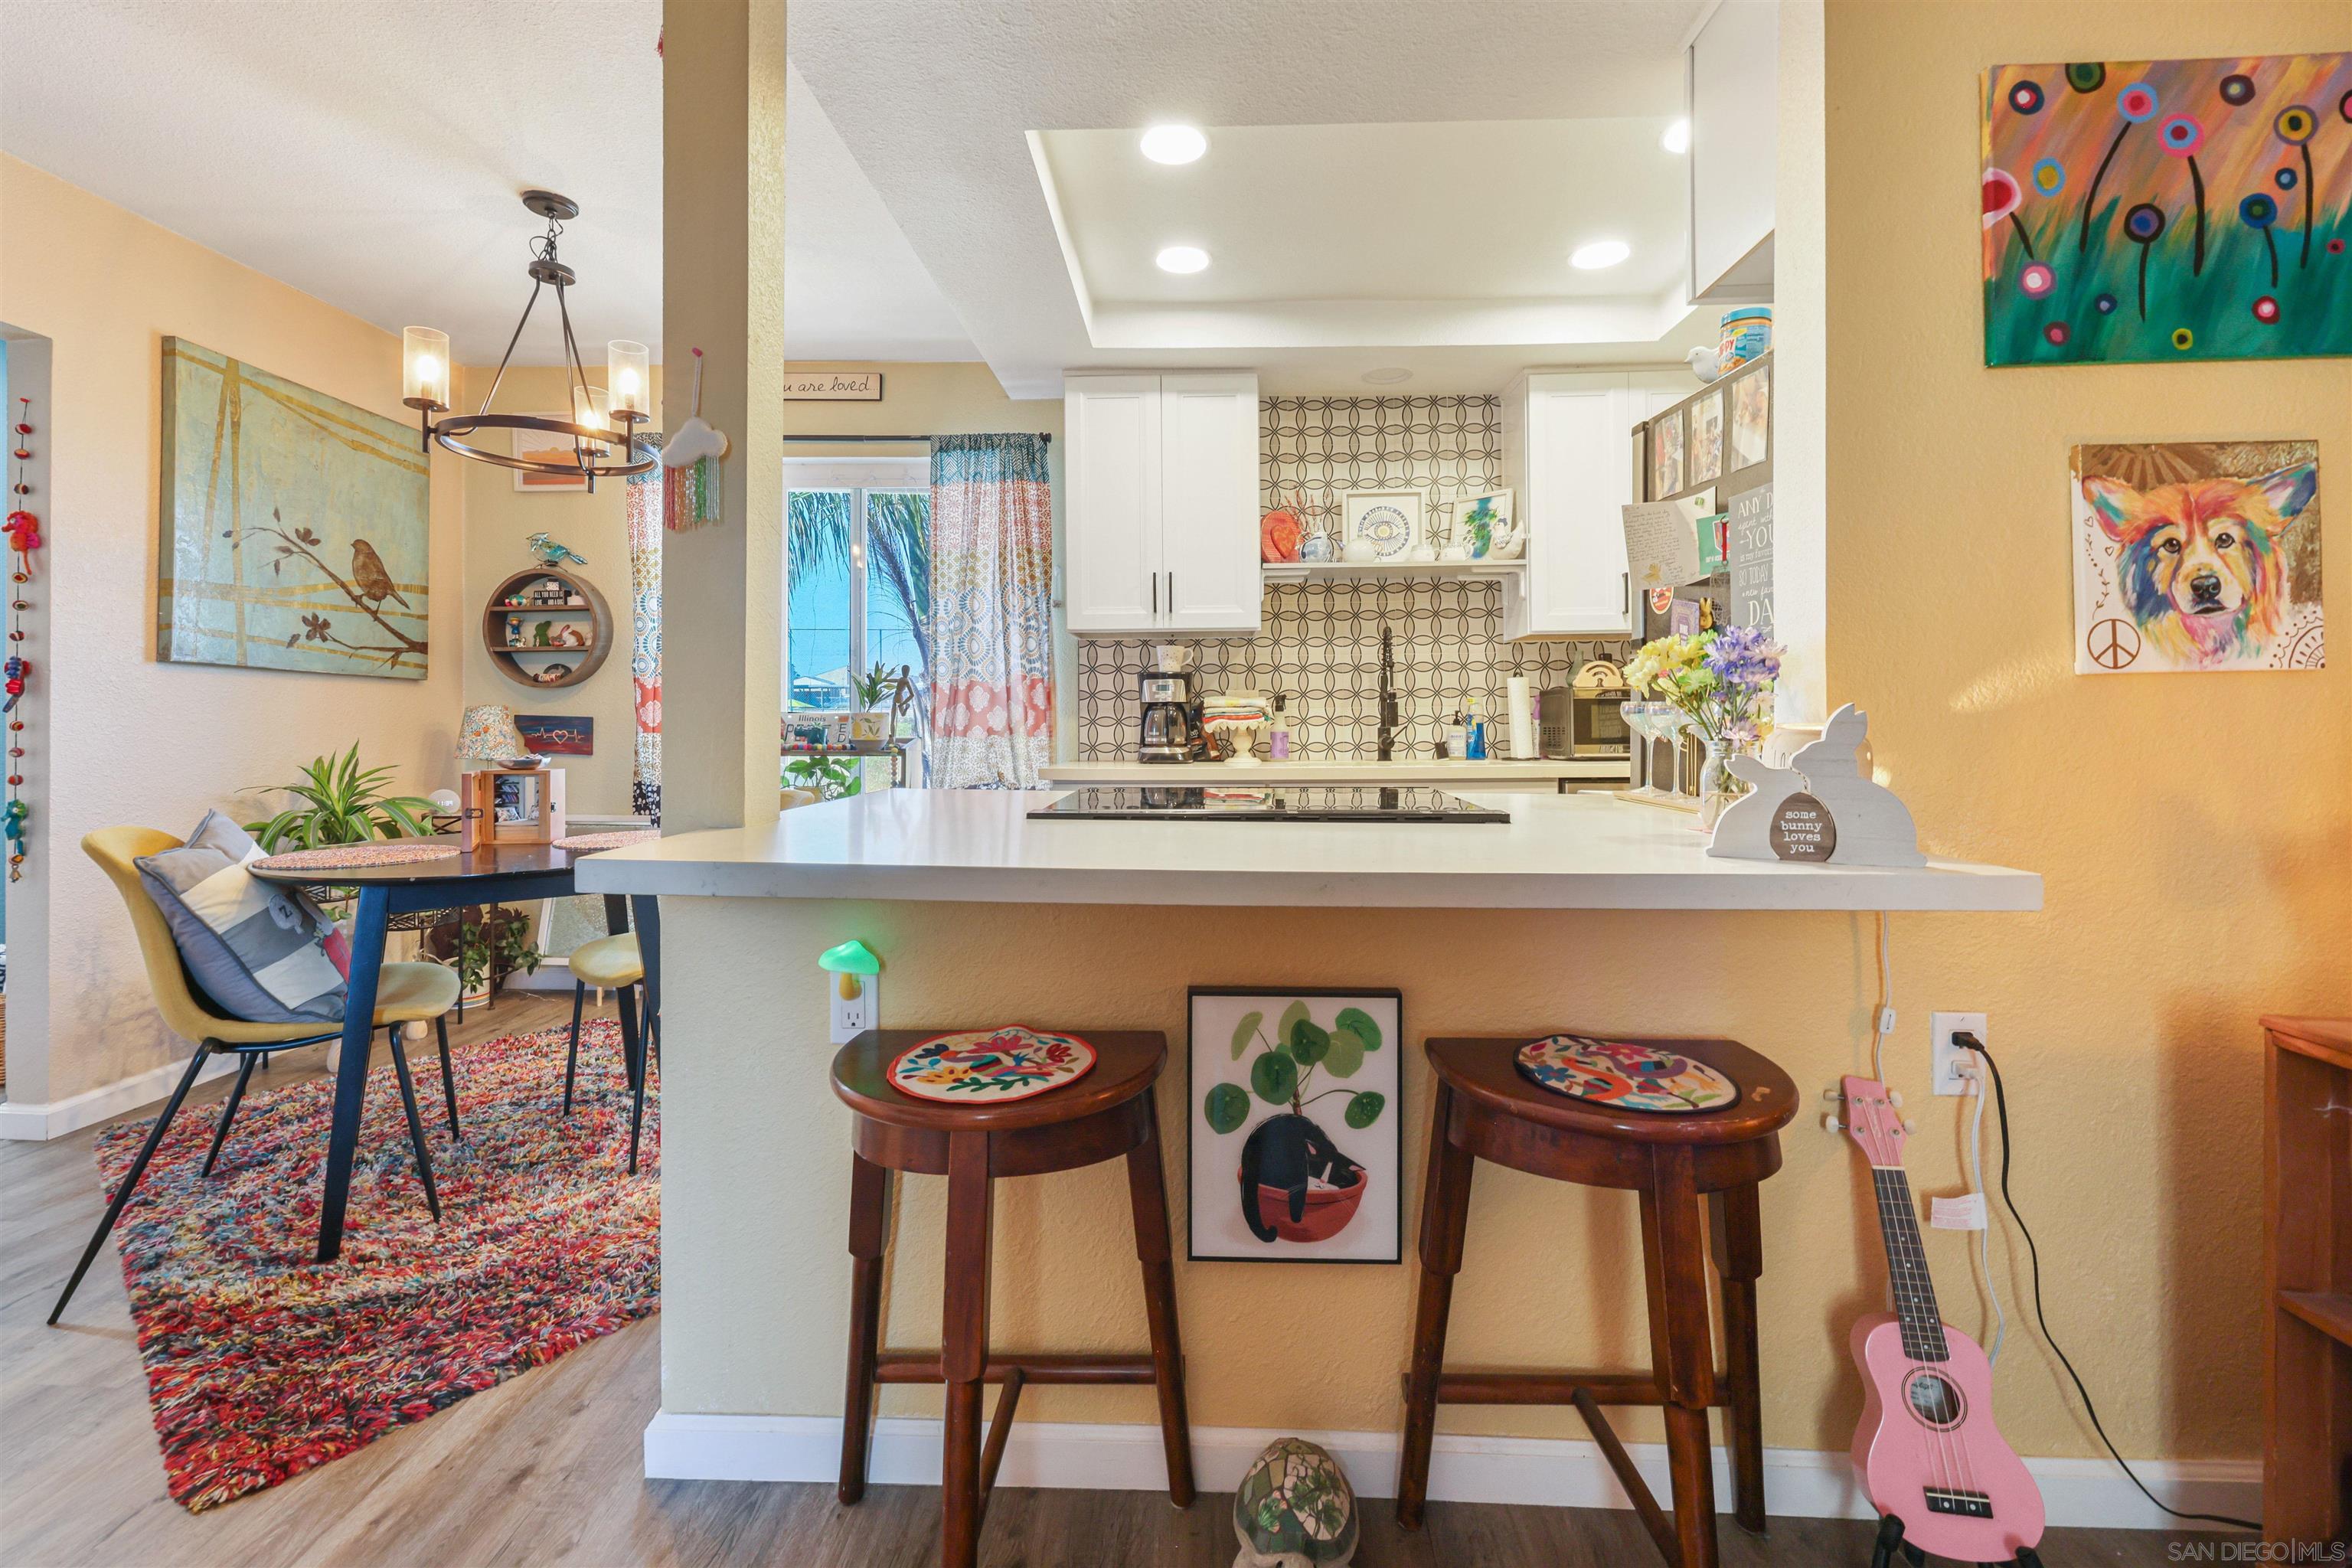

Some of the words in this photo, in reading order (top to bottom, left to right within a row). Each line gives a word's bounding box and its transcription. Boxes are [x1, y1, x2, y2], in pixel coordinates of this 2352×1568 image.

[799, 384, 826, 392] are
[1738, 495, 1761, 519] ANY
[1749, 564, 1769, 585] TODAY
[1748, 599, 1774, 626] DA
[1785, 810, 1817, 819] some
[1780, 821, 1822, 832] bunny
[1783, 831, 1821, 841] loves
[1790, 844, 1815, 854] you
